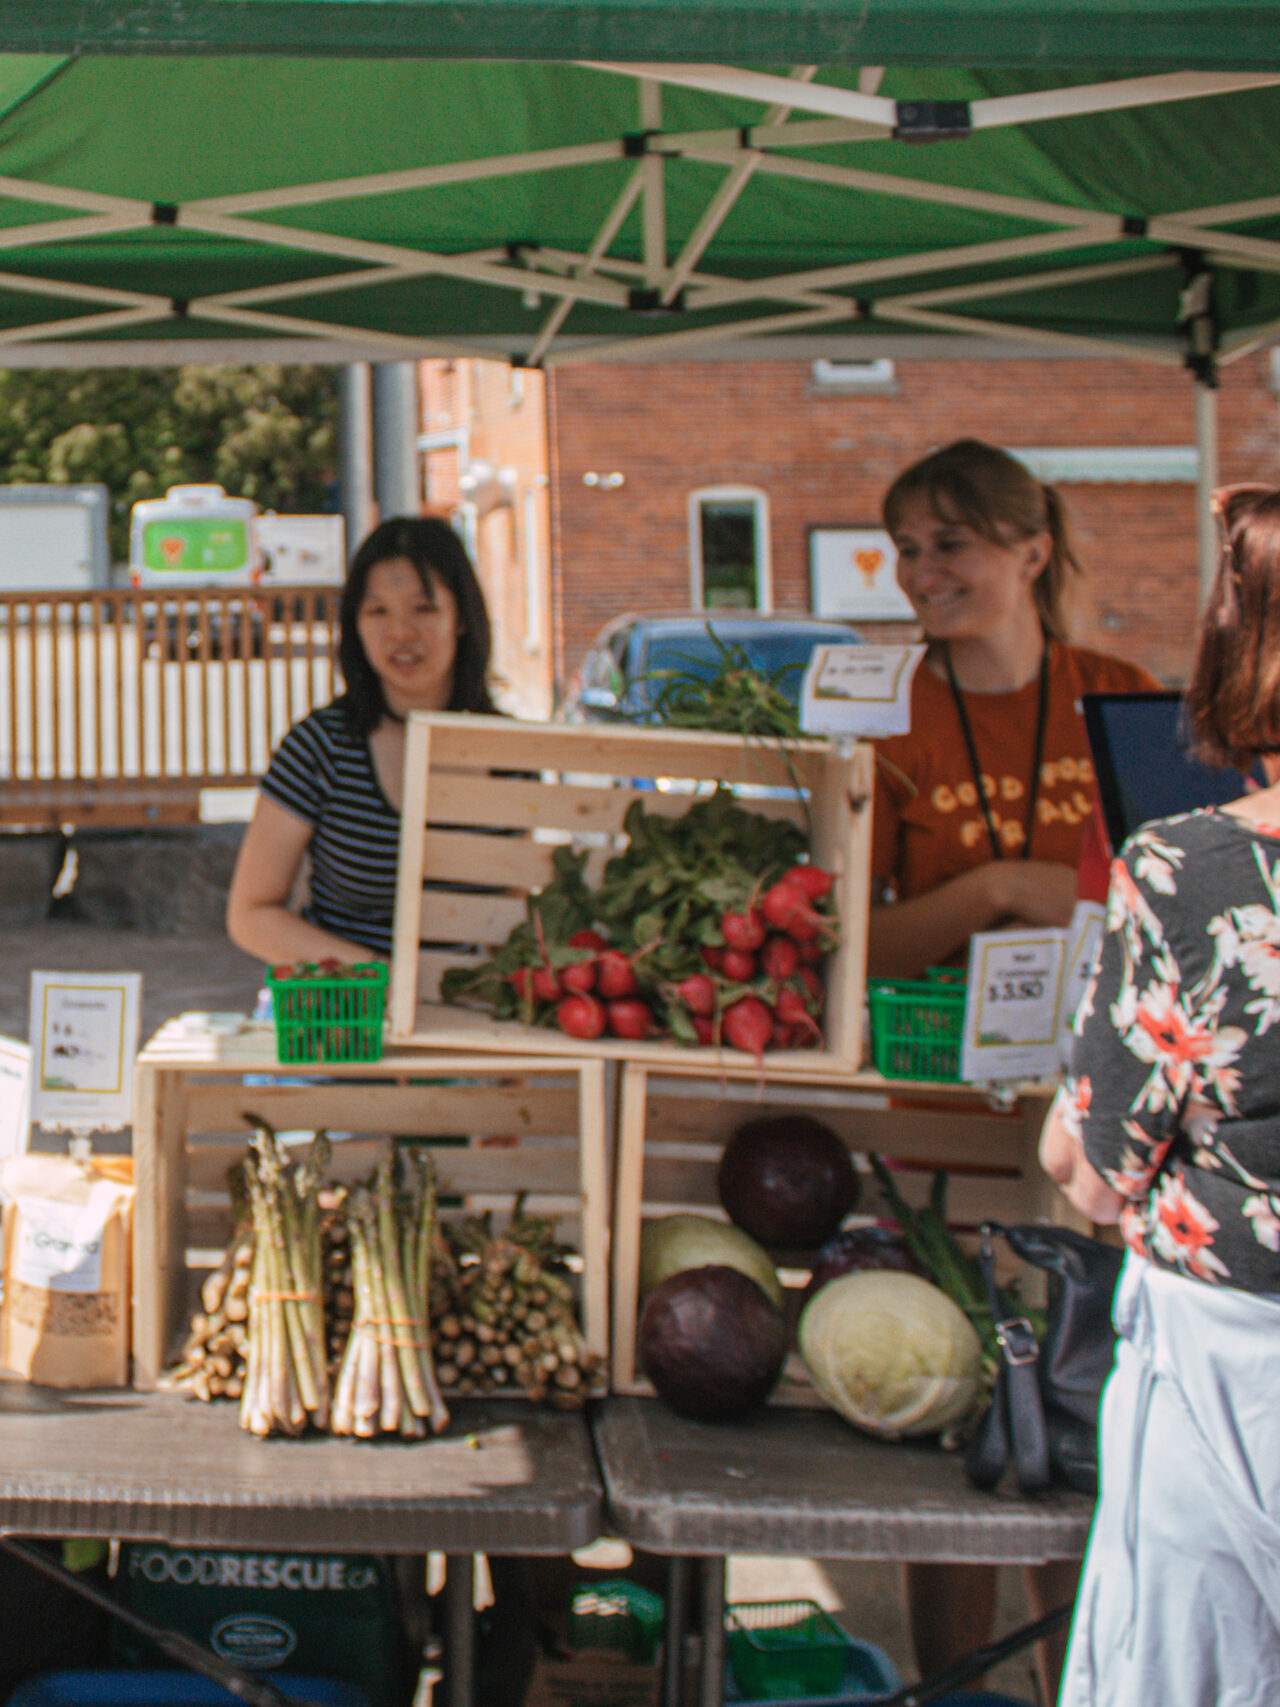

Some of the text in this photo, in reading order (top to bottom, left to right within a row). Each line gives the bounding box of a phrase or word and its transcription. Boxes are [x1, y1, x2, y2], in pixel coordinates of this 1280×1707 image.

[931, 756, 1094, 814] GOOD FOO
[1036, 791, 1093, 826] ALL
